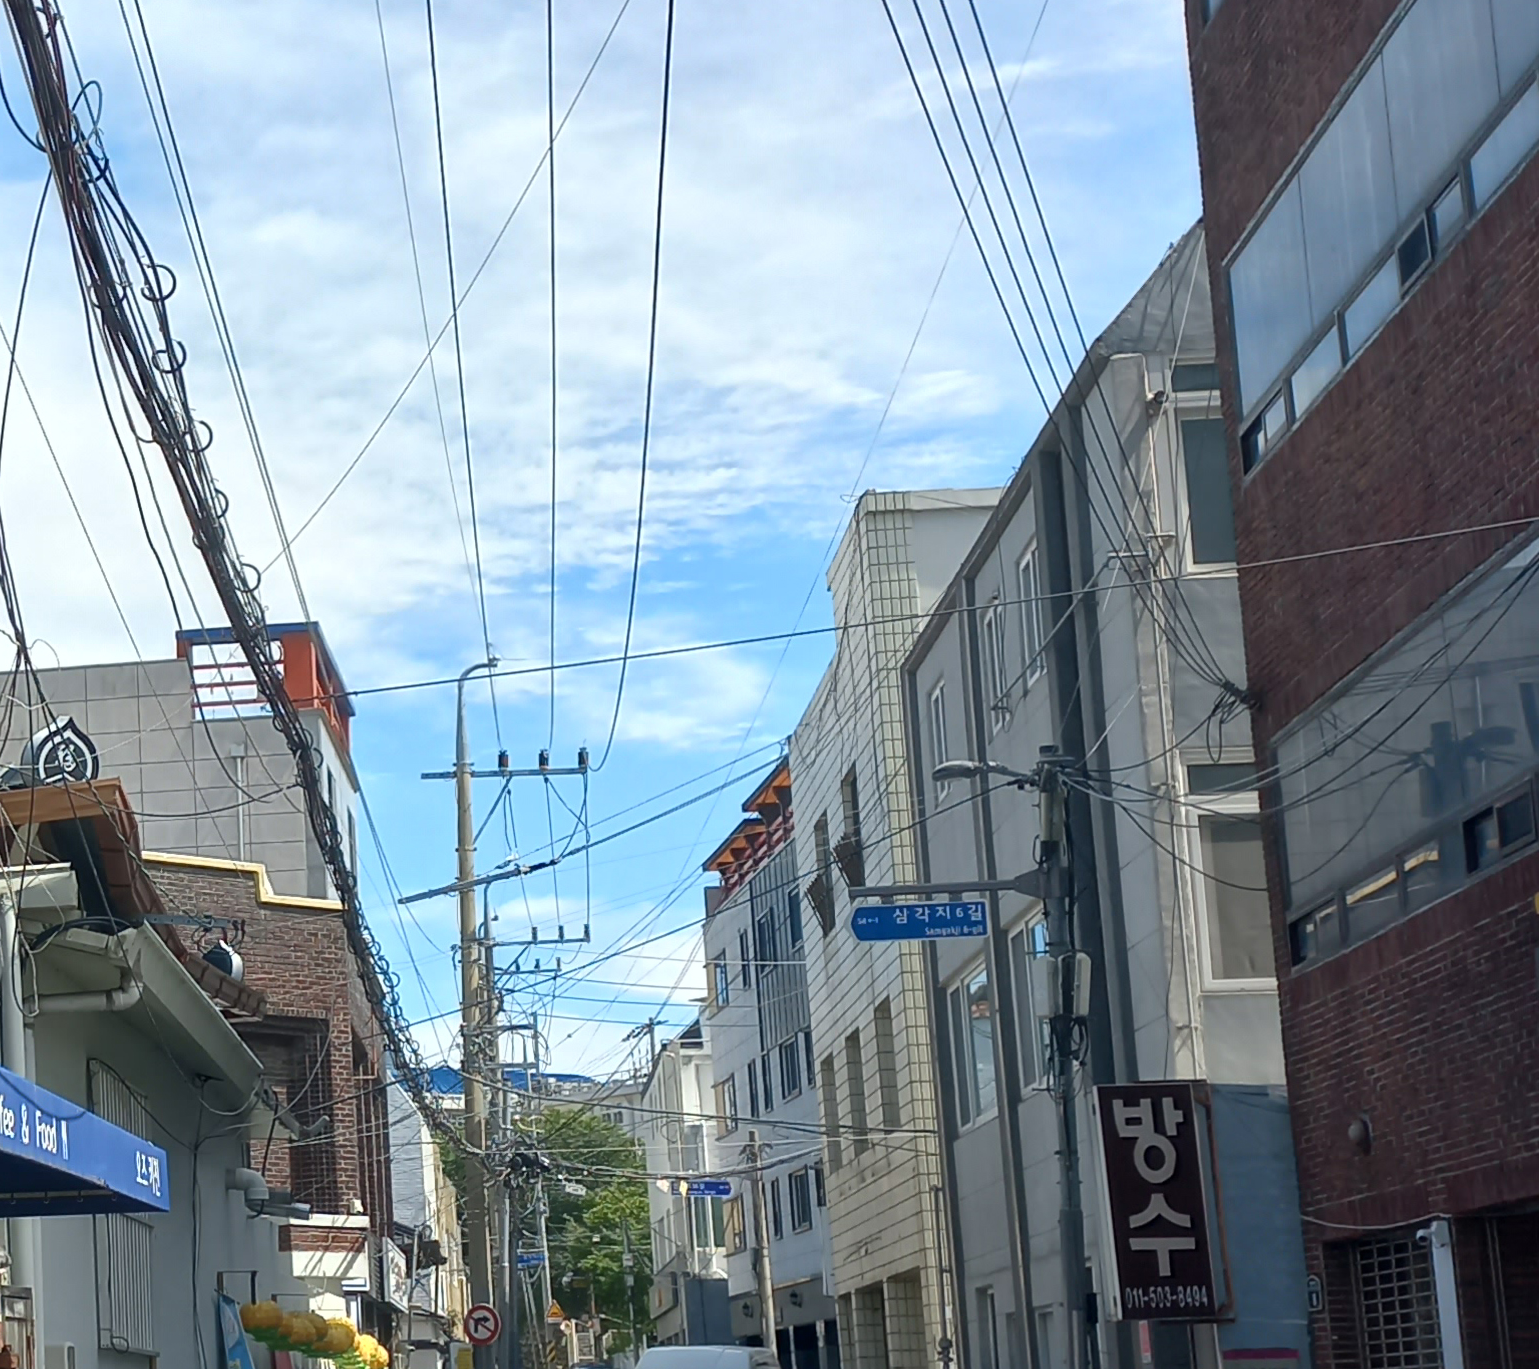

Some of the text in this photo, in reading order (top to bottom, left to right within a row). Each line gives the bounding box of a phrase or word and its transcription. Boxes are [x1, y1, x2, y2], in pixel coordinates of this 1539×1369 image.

[21, 1103, 29, 1145] &
[35, 1110, 57, 1155] Food
[1112, 1096, 1196, 1277] 방수
[1124, 1284, 1209, 1309] 011-503-8494
